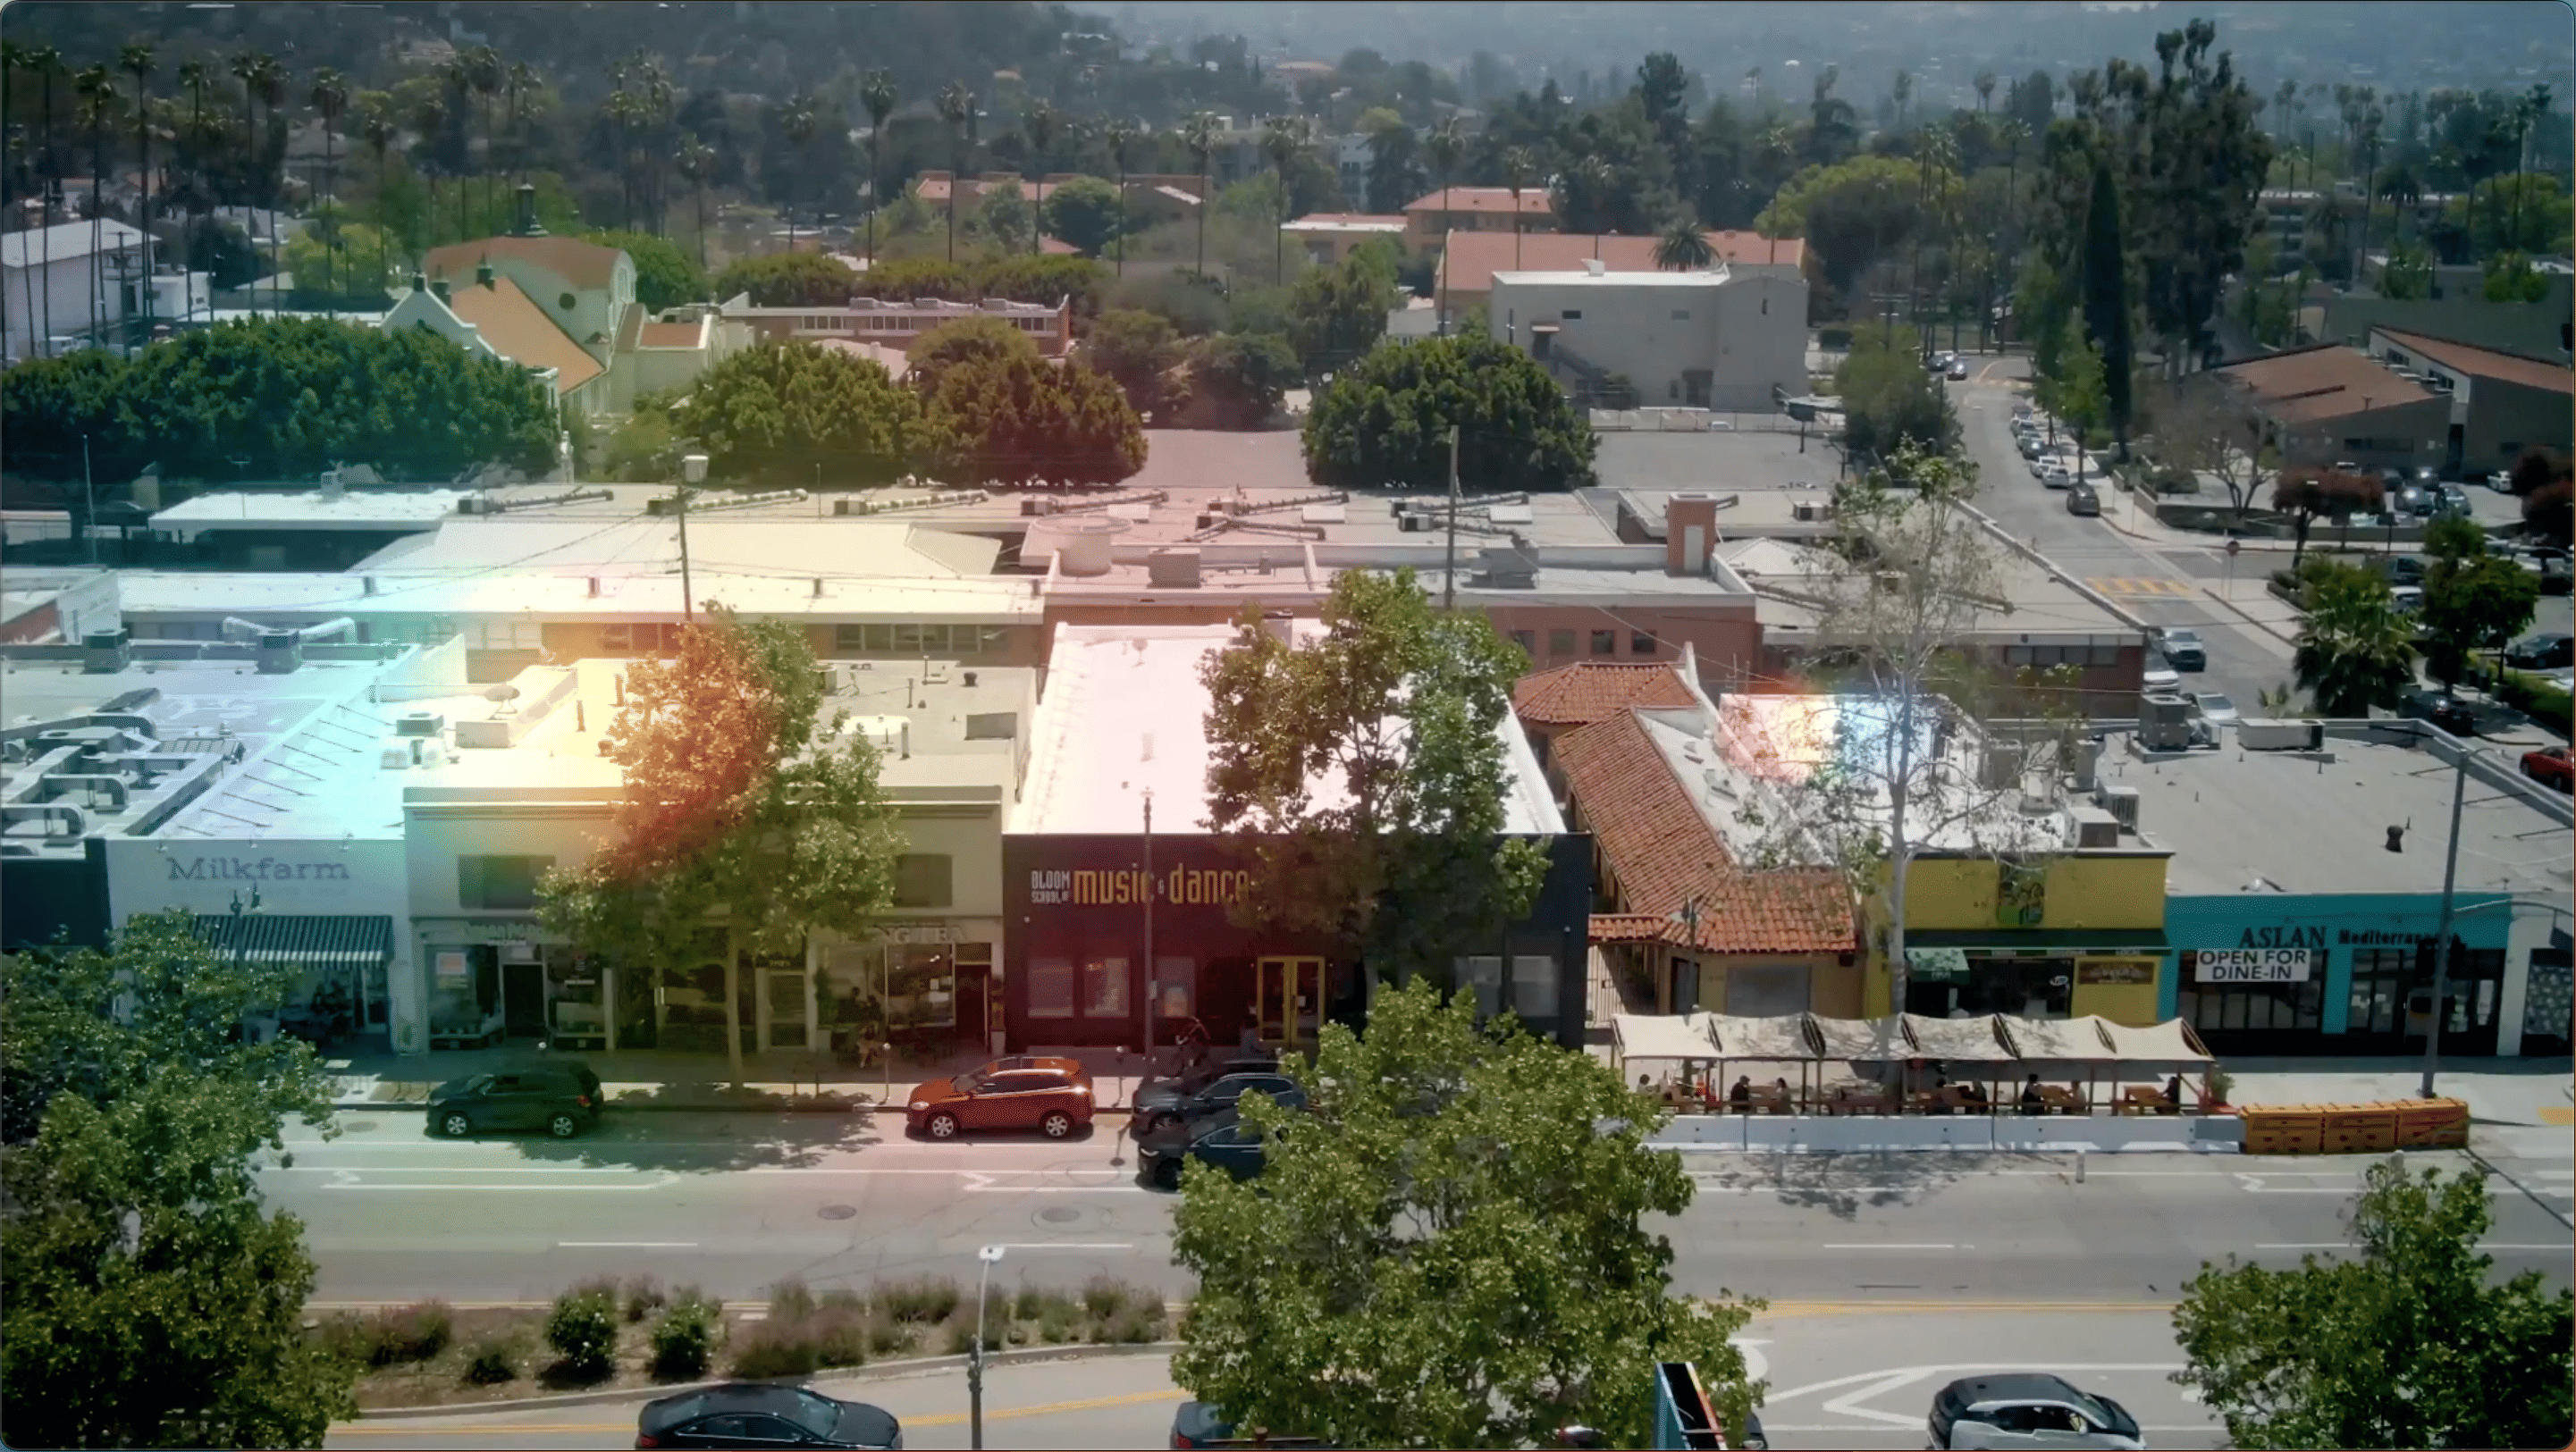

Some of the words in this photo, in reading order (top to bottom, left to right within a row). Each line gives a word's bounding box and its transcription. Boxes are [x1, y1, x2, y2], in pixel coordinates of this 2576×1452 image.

[166, 856, 349, 880] Milkfarm
[1031, 869, 1071, 889] BLOOM
[1073, 862, 1155, 904] music
[2238, 926, 2327, 948] ASLAN
[2200, 950, 2258, 964] OPEN
[2265, 950, 2307, 964] FOR
[2212, 966, 2292, 979] DINE-IN
